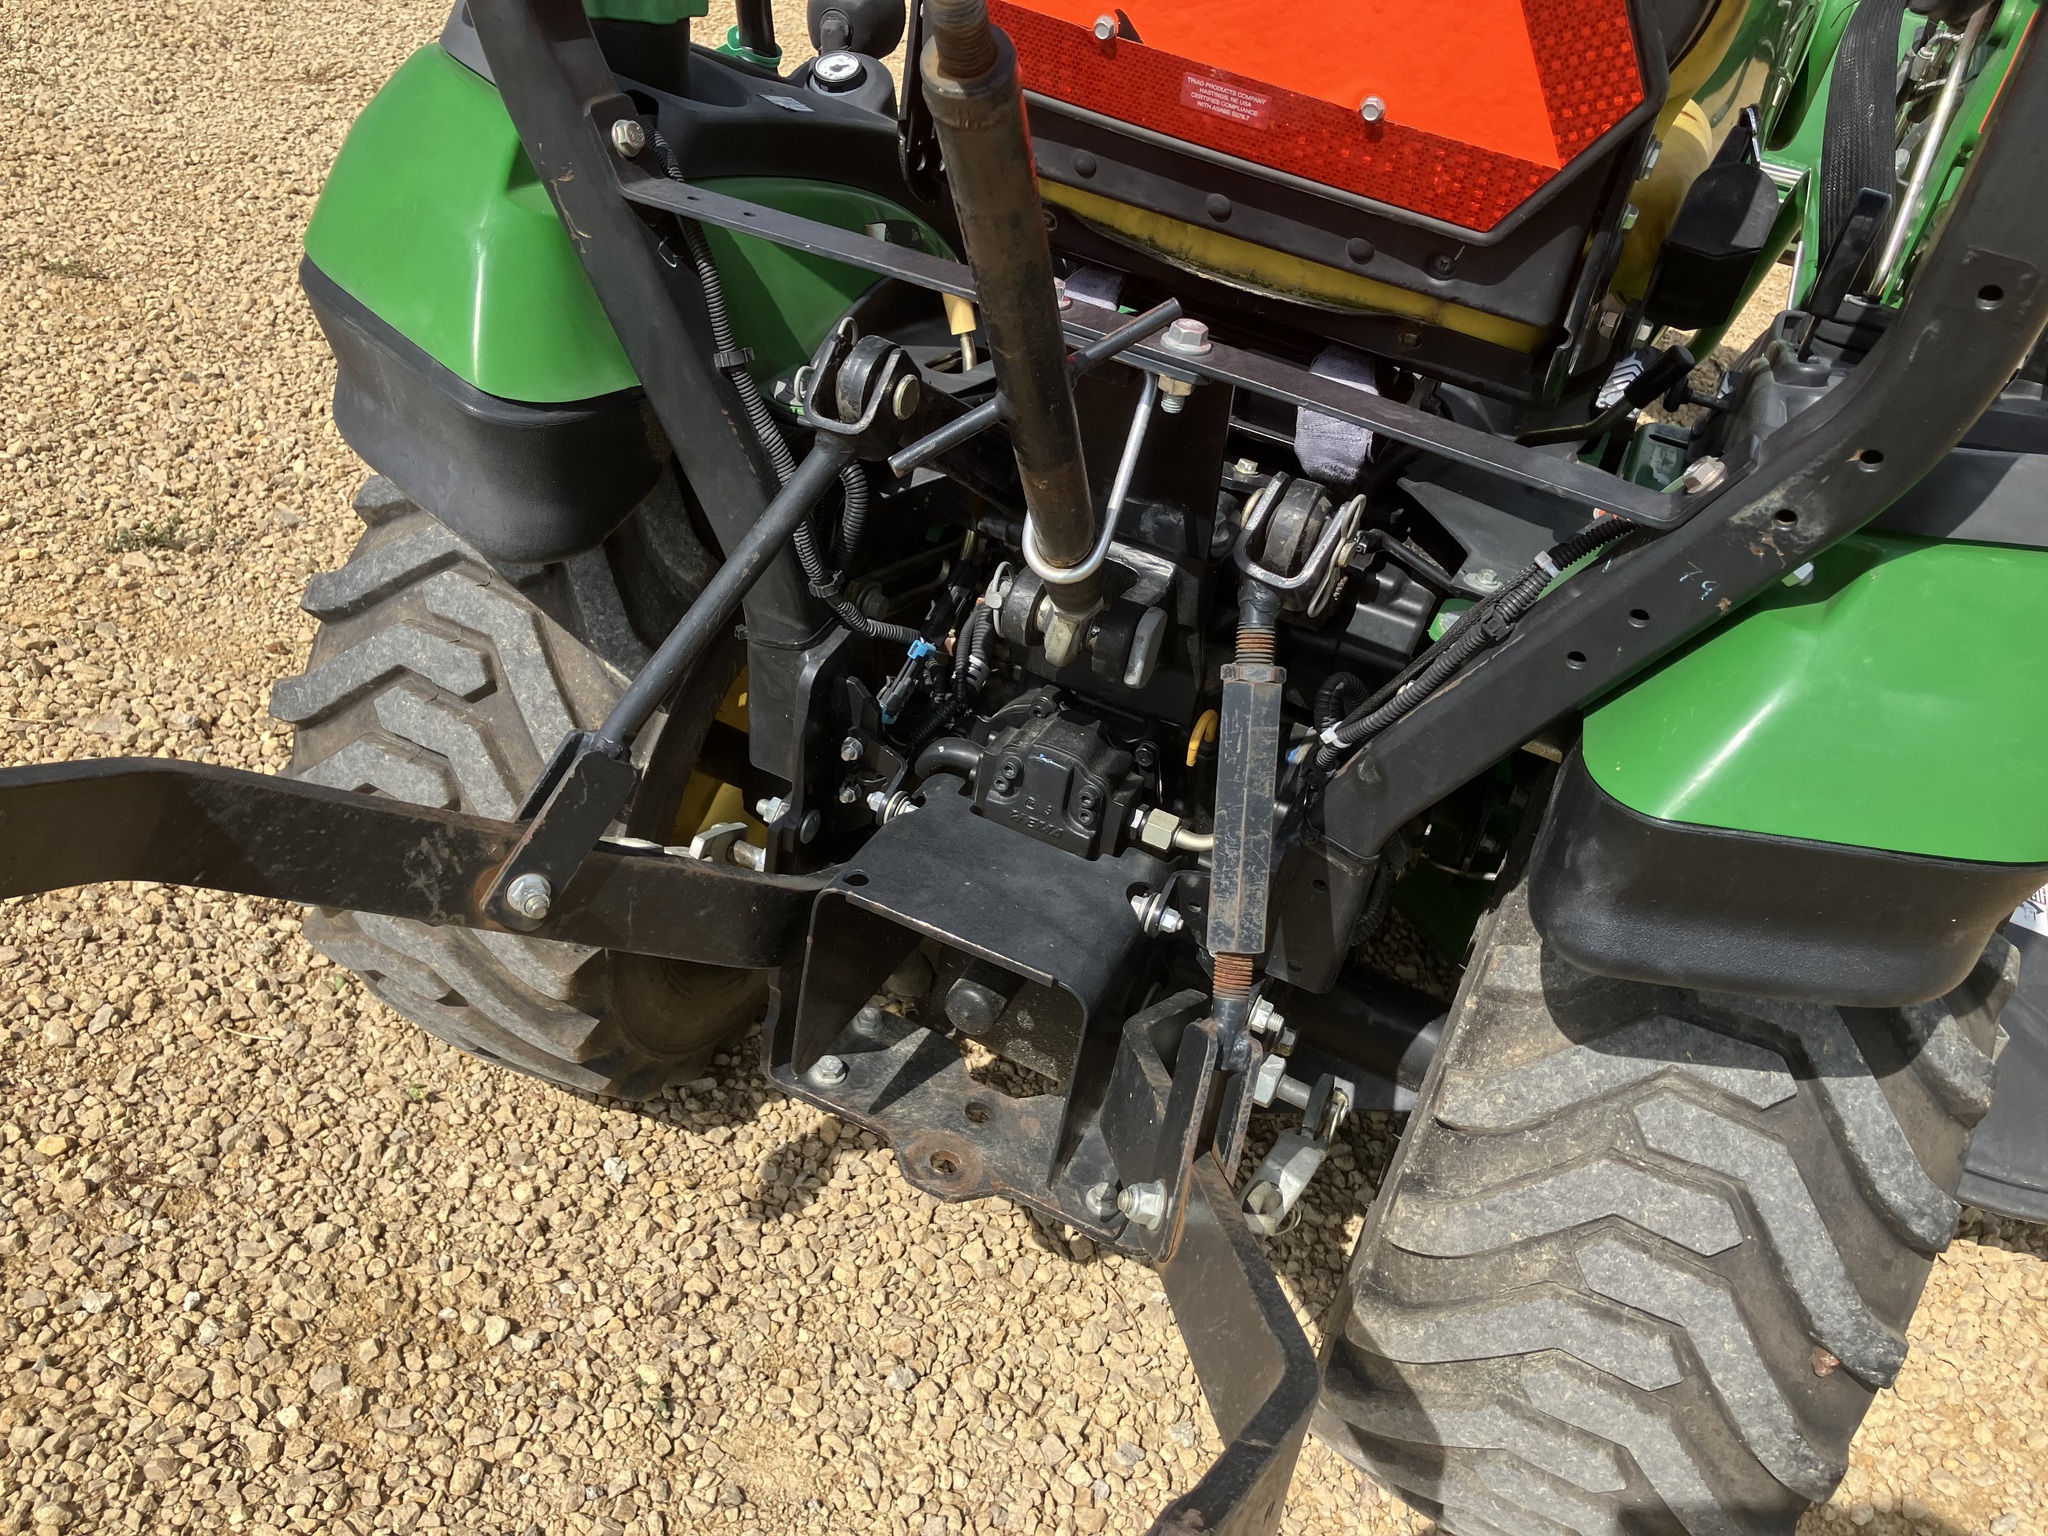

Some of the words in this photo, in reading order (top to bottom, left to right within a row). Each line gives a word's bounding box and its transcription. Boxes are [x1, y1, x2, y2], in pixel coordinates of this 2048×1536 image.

[1188, 77, 1204, 86] TRIAD
[1205, 82, 1236, 96] PRODUCTS
[1238, 92, 1266, 104] COMPANY
[1197, 100, 1211, 109] WITH
[1221, 101, 1258, 117] COMPLIANCE
[1240, 99, 1251, 107] USA
